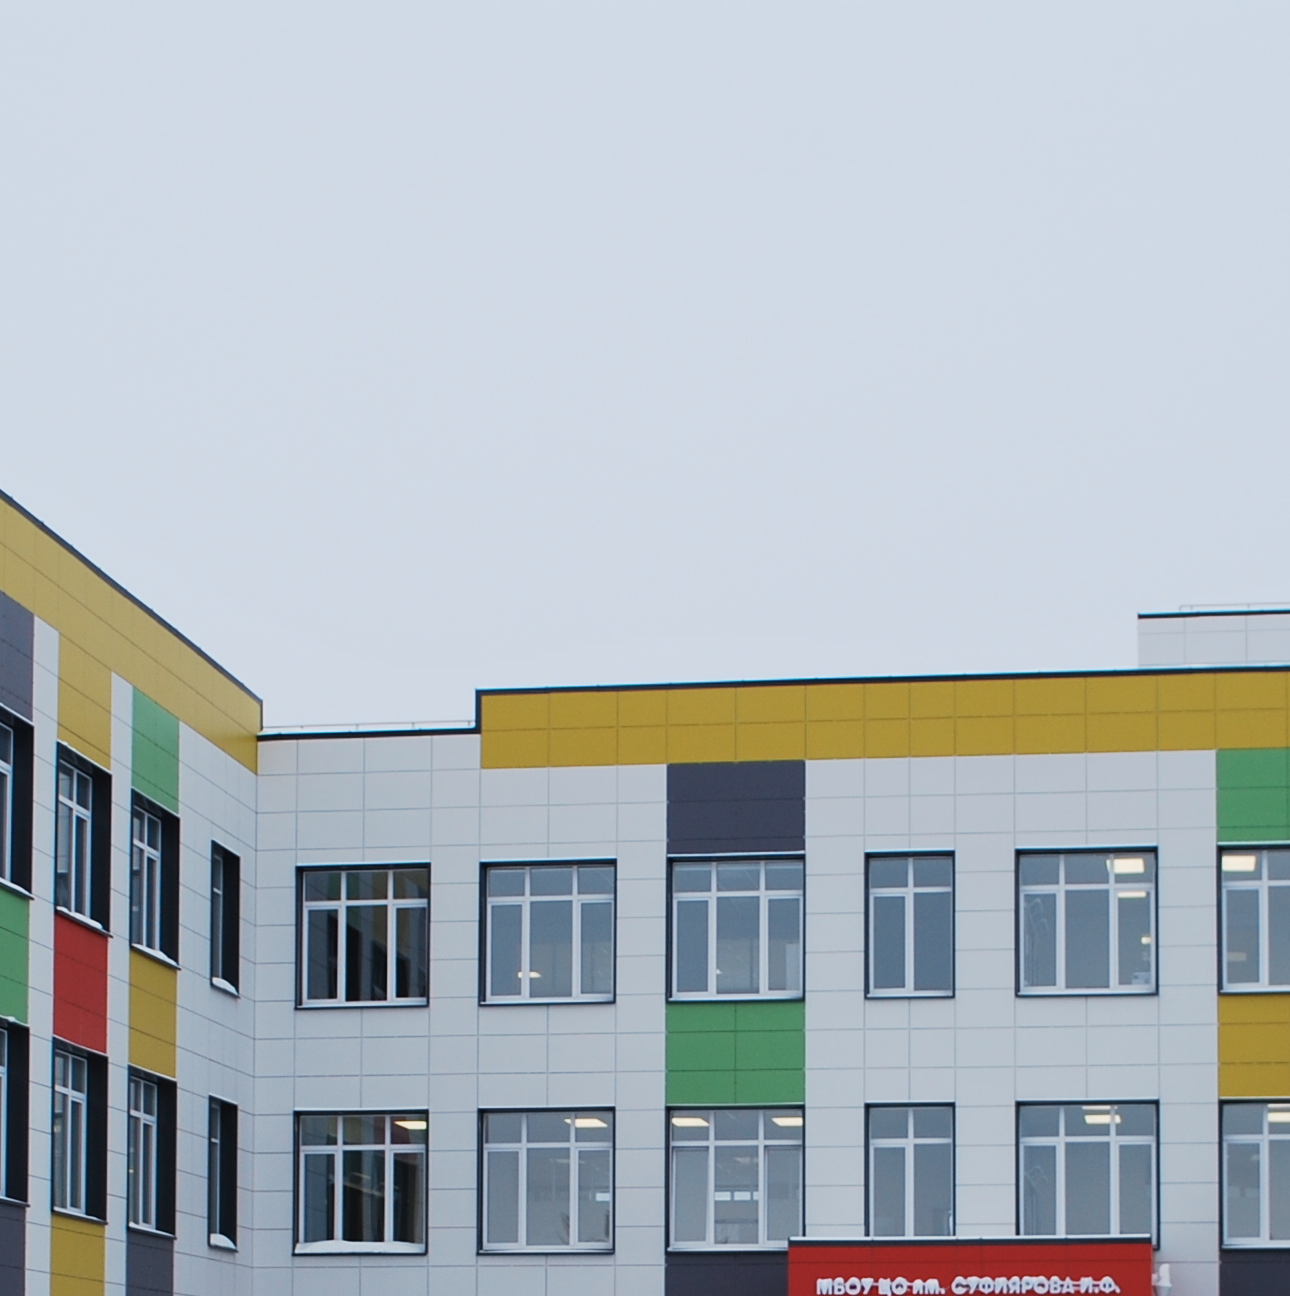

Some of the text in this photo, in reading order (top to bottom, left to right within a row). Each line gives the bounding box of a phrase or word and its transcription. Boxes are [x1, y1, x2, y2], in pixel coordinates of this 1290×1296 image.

[816, 1276, 874, 1295] МБОУ
[877, 1276, 908, 1296] ЦО
[951, 1275, 1075, 1295] СУФИЯРОВА
